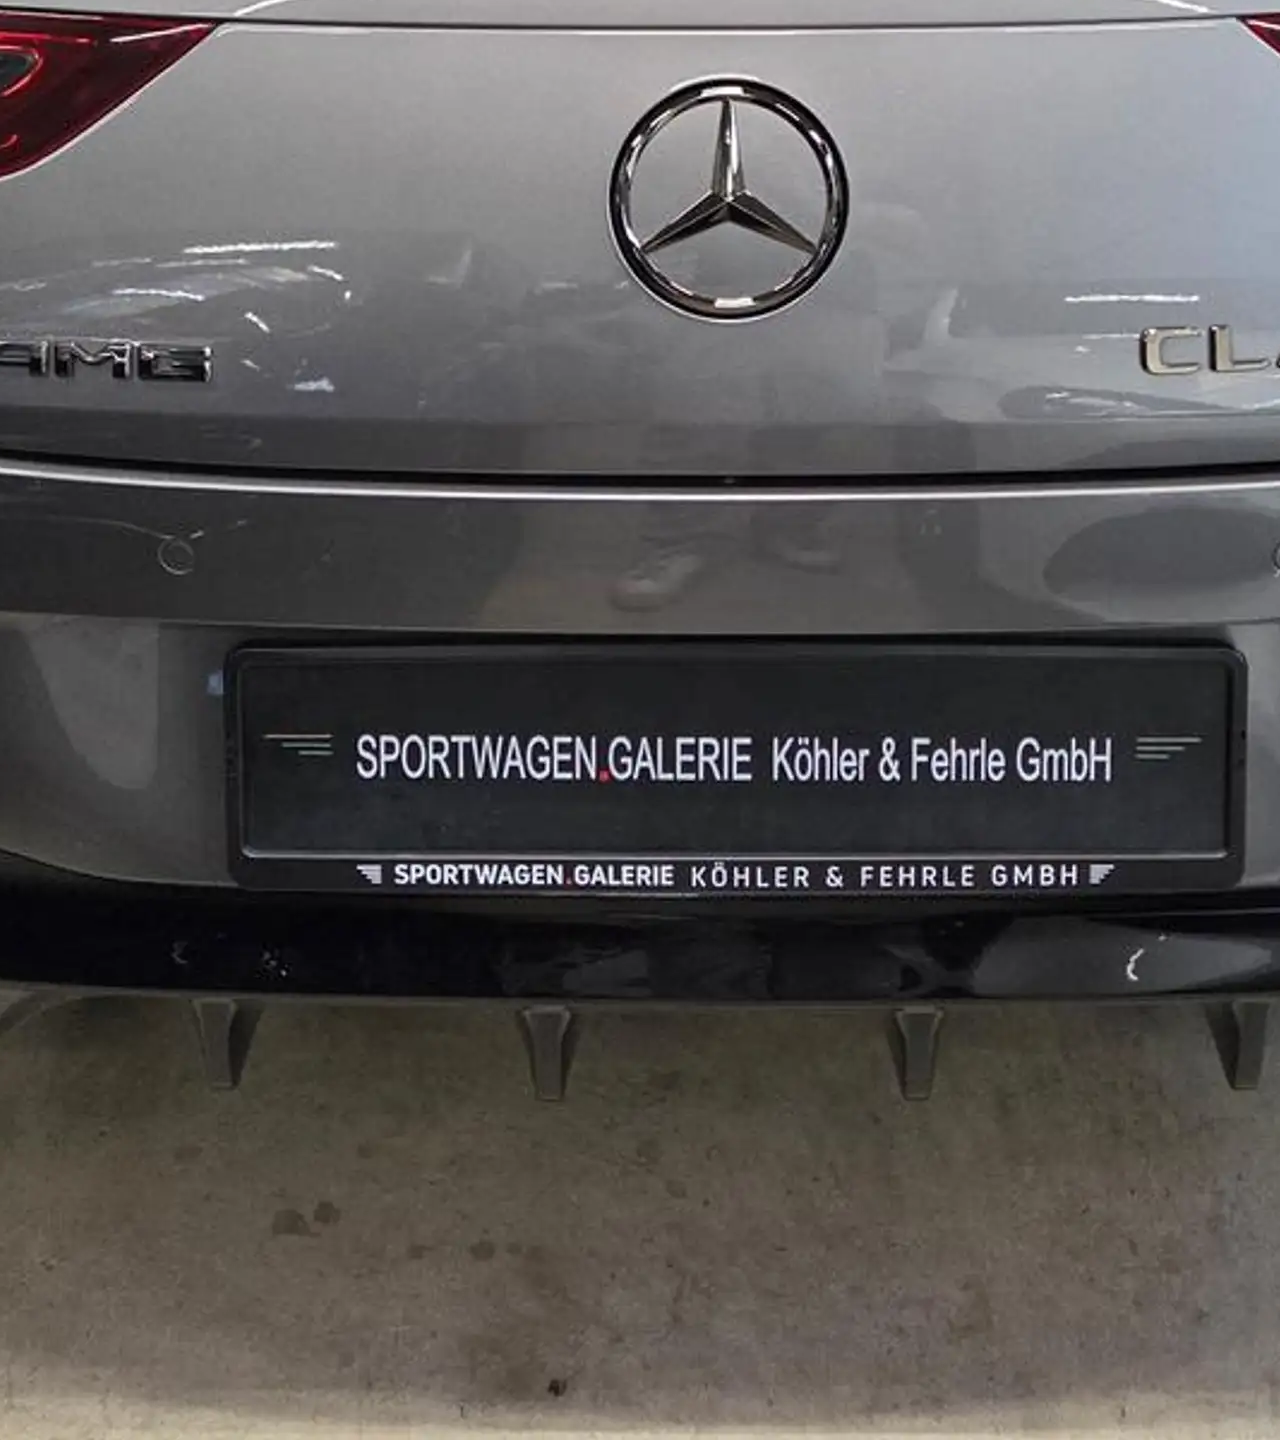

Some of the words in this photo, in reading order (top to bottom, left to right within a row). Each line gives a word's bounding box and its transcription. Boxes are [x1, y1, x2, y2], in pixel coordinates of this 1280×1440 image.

[356, 734, 753, 782] SPORTWAGEN.GALERIE
[772, 737, 870, 782] Köhler
[878, 737, 901, 782] &
[911, 737, 1006, 782] Fehrle
[1016, 737, 1112, 782] GmbH
[691, 862, 811, 888] KÖHLER
[825, 866, 844, 888] &
[860, 864, 975, 888] FEHRLE
[991, 864, 1079, 887] GMBH
